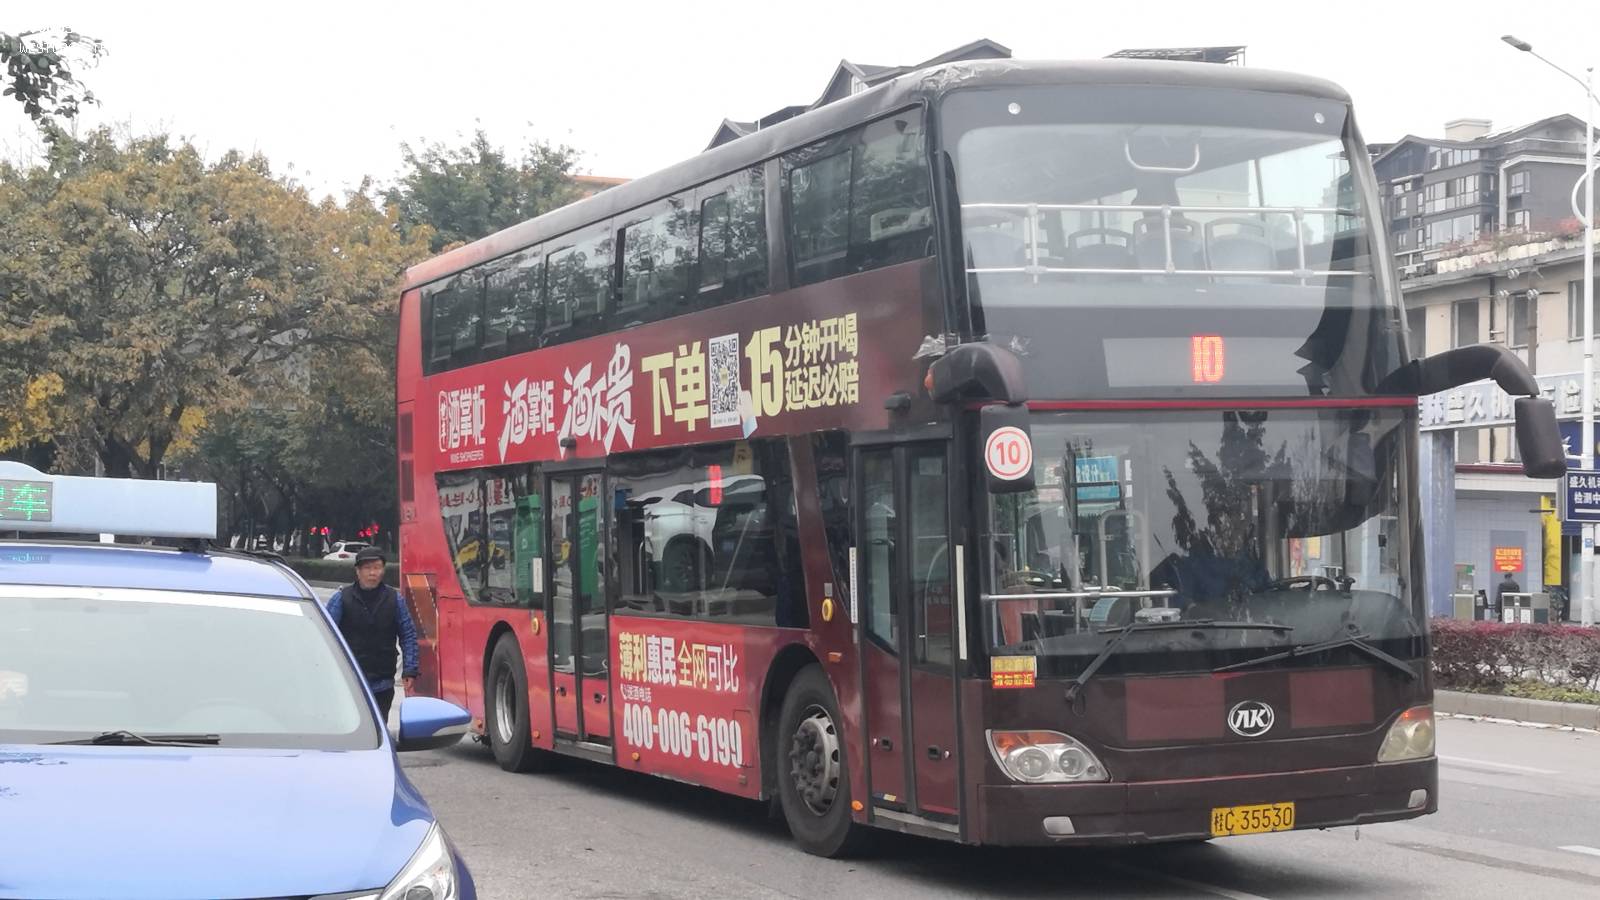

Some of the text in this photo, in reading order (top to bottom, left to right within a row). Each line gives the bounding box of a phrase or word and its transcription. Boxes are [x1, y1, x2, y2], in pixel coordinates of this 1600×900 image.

[785, 313, 858, 368] 分钟开喝
[1192, 336, 1224, 382] 10
[641, 341, 709, 435] 下单
[745, 326, 783, 417] 15
[784, 359, 859, 412] 延迟必赔
[448, 384, 486, 448] 酒掌柜
[499, 377, 555, 463] 酒掌柜
[996, 441, 1021, 465] 10
[0, 484, 48, 520] 车
[623, 702, 743, 768] 400-006-6199
